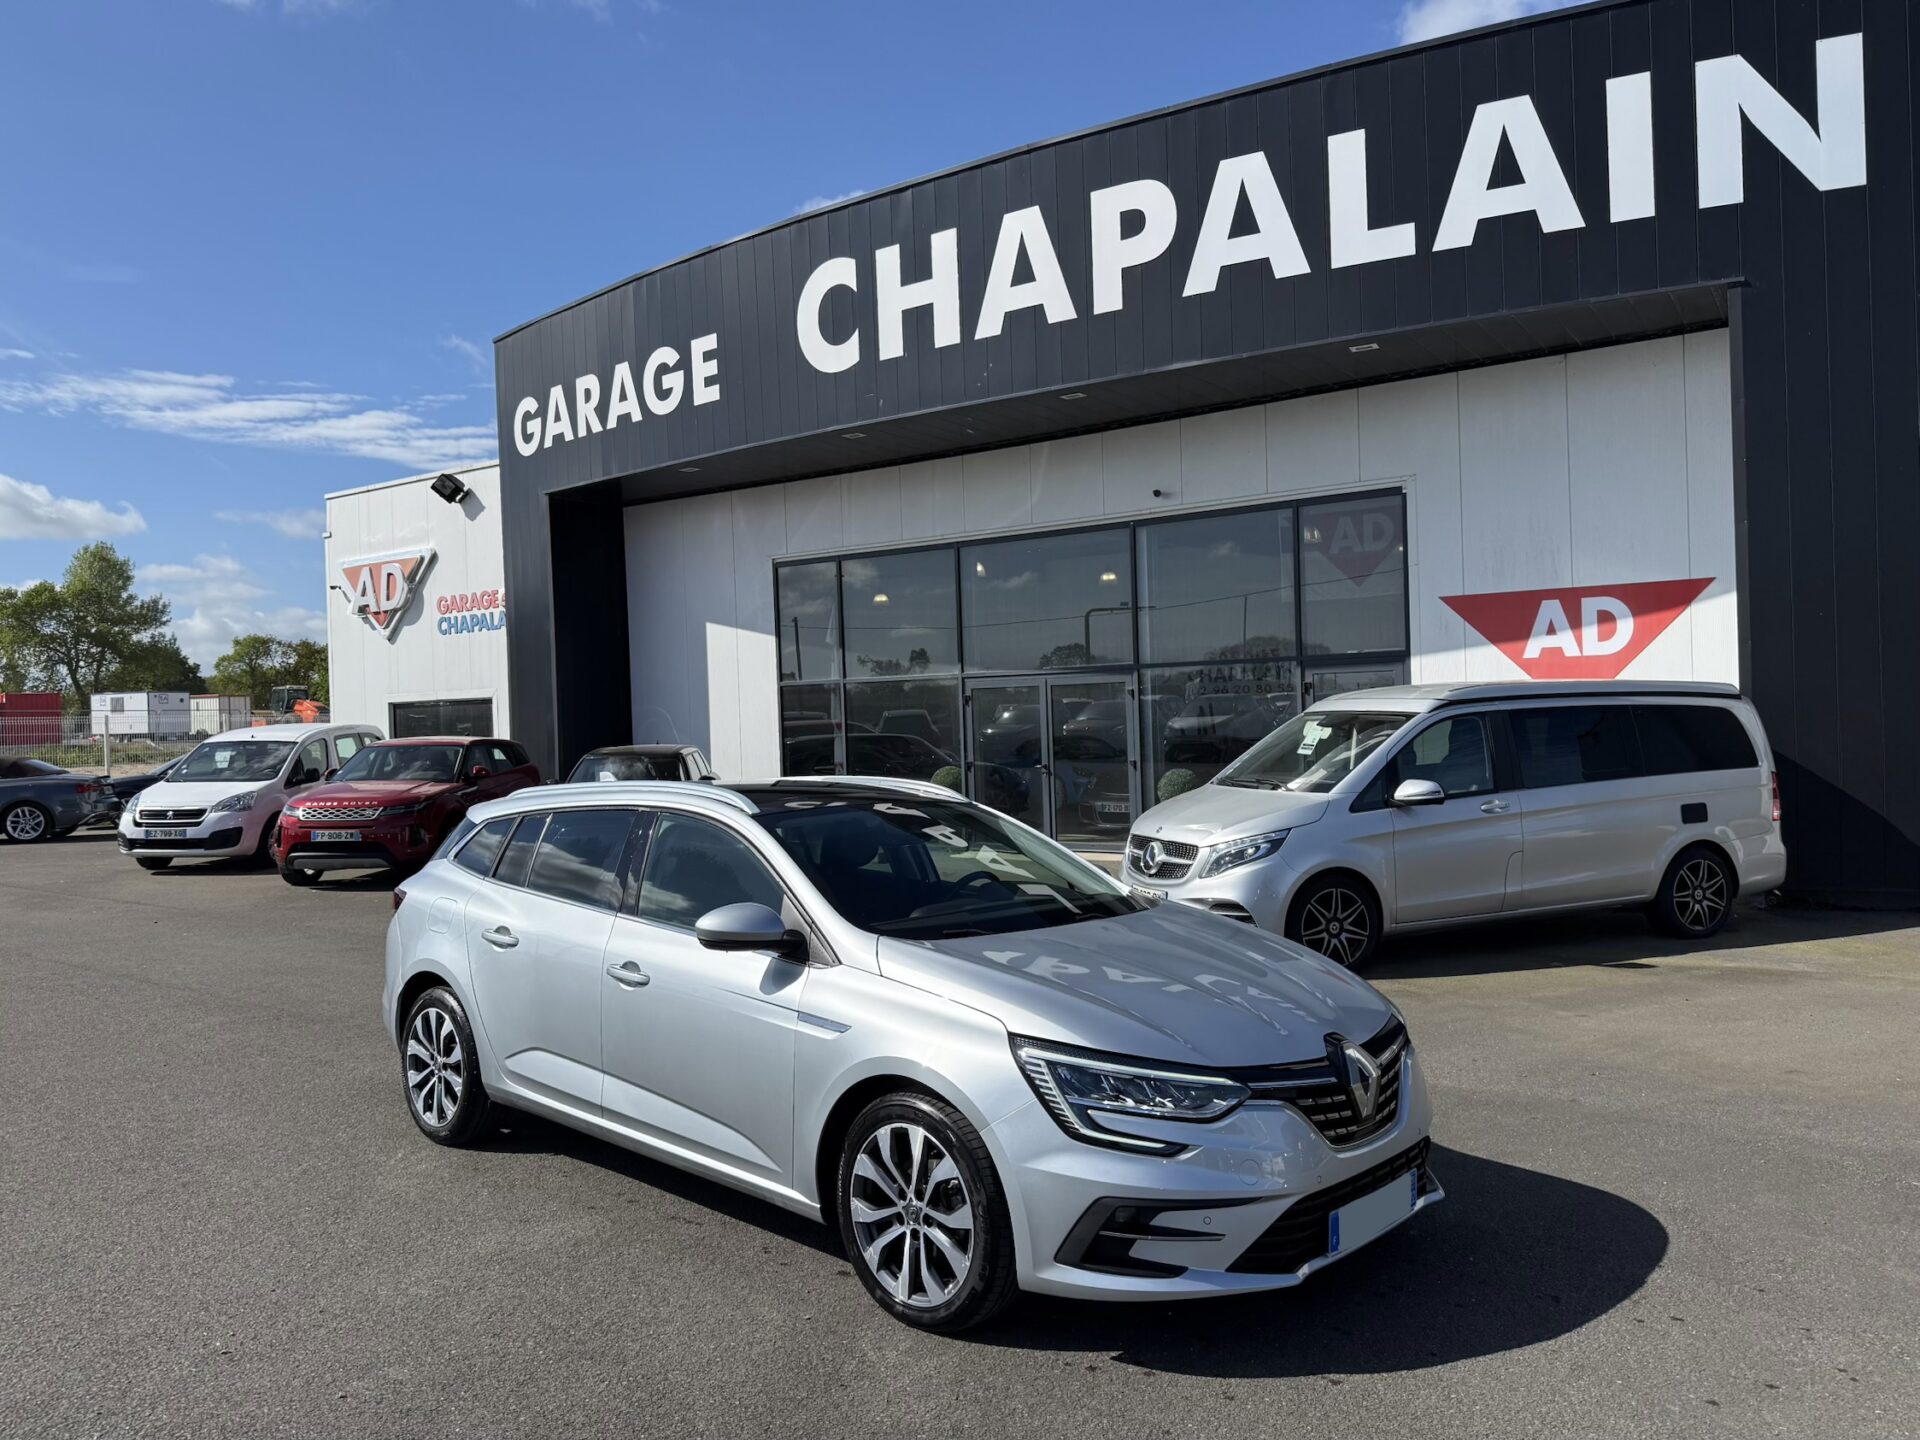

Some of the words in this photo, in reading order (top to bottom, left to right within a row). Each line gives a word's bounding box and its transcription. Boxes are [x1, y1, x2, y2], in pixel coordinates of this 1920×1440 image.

[514, 333, 720, 457] GARAGE
[797, 32, 1868, 374] CHAPALAIN
[1328, 512, 1394, 554] AD
[352, 563, 406, 616] AD
[1522, 596, 1635, 659] AD
